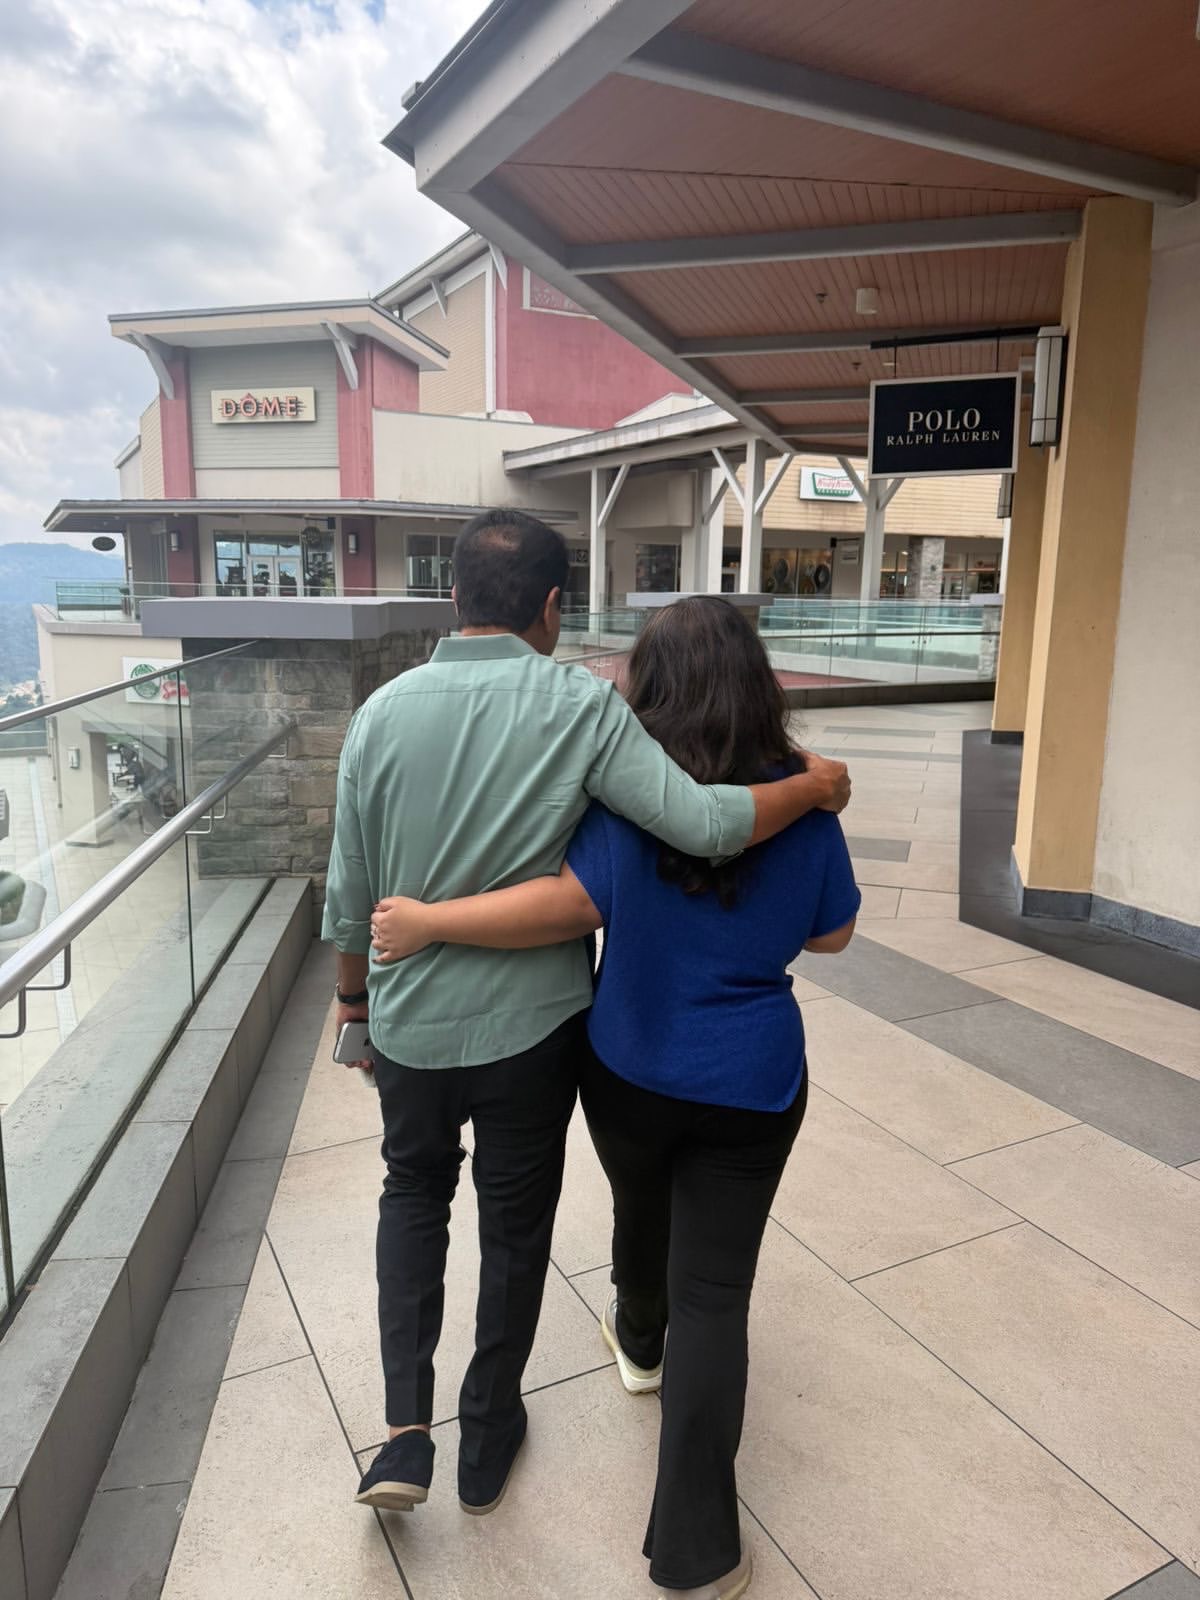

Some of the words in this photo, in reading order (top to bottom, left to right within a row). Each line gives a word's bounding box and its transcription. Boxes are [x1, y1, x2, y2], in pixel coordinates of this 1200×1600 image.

[222, 392, 298, 417] DÔME
[908, 408, 981, 432] POLO
[887, 433, 933, 446] RALPH
[943, 430, 1001, 443] LAUREN
